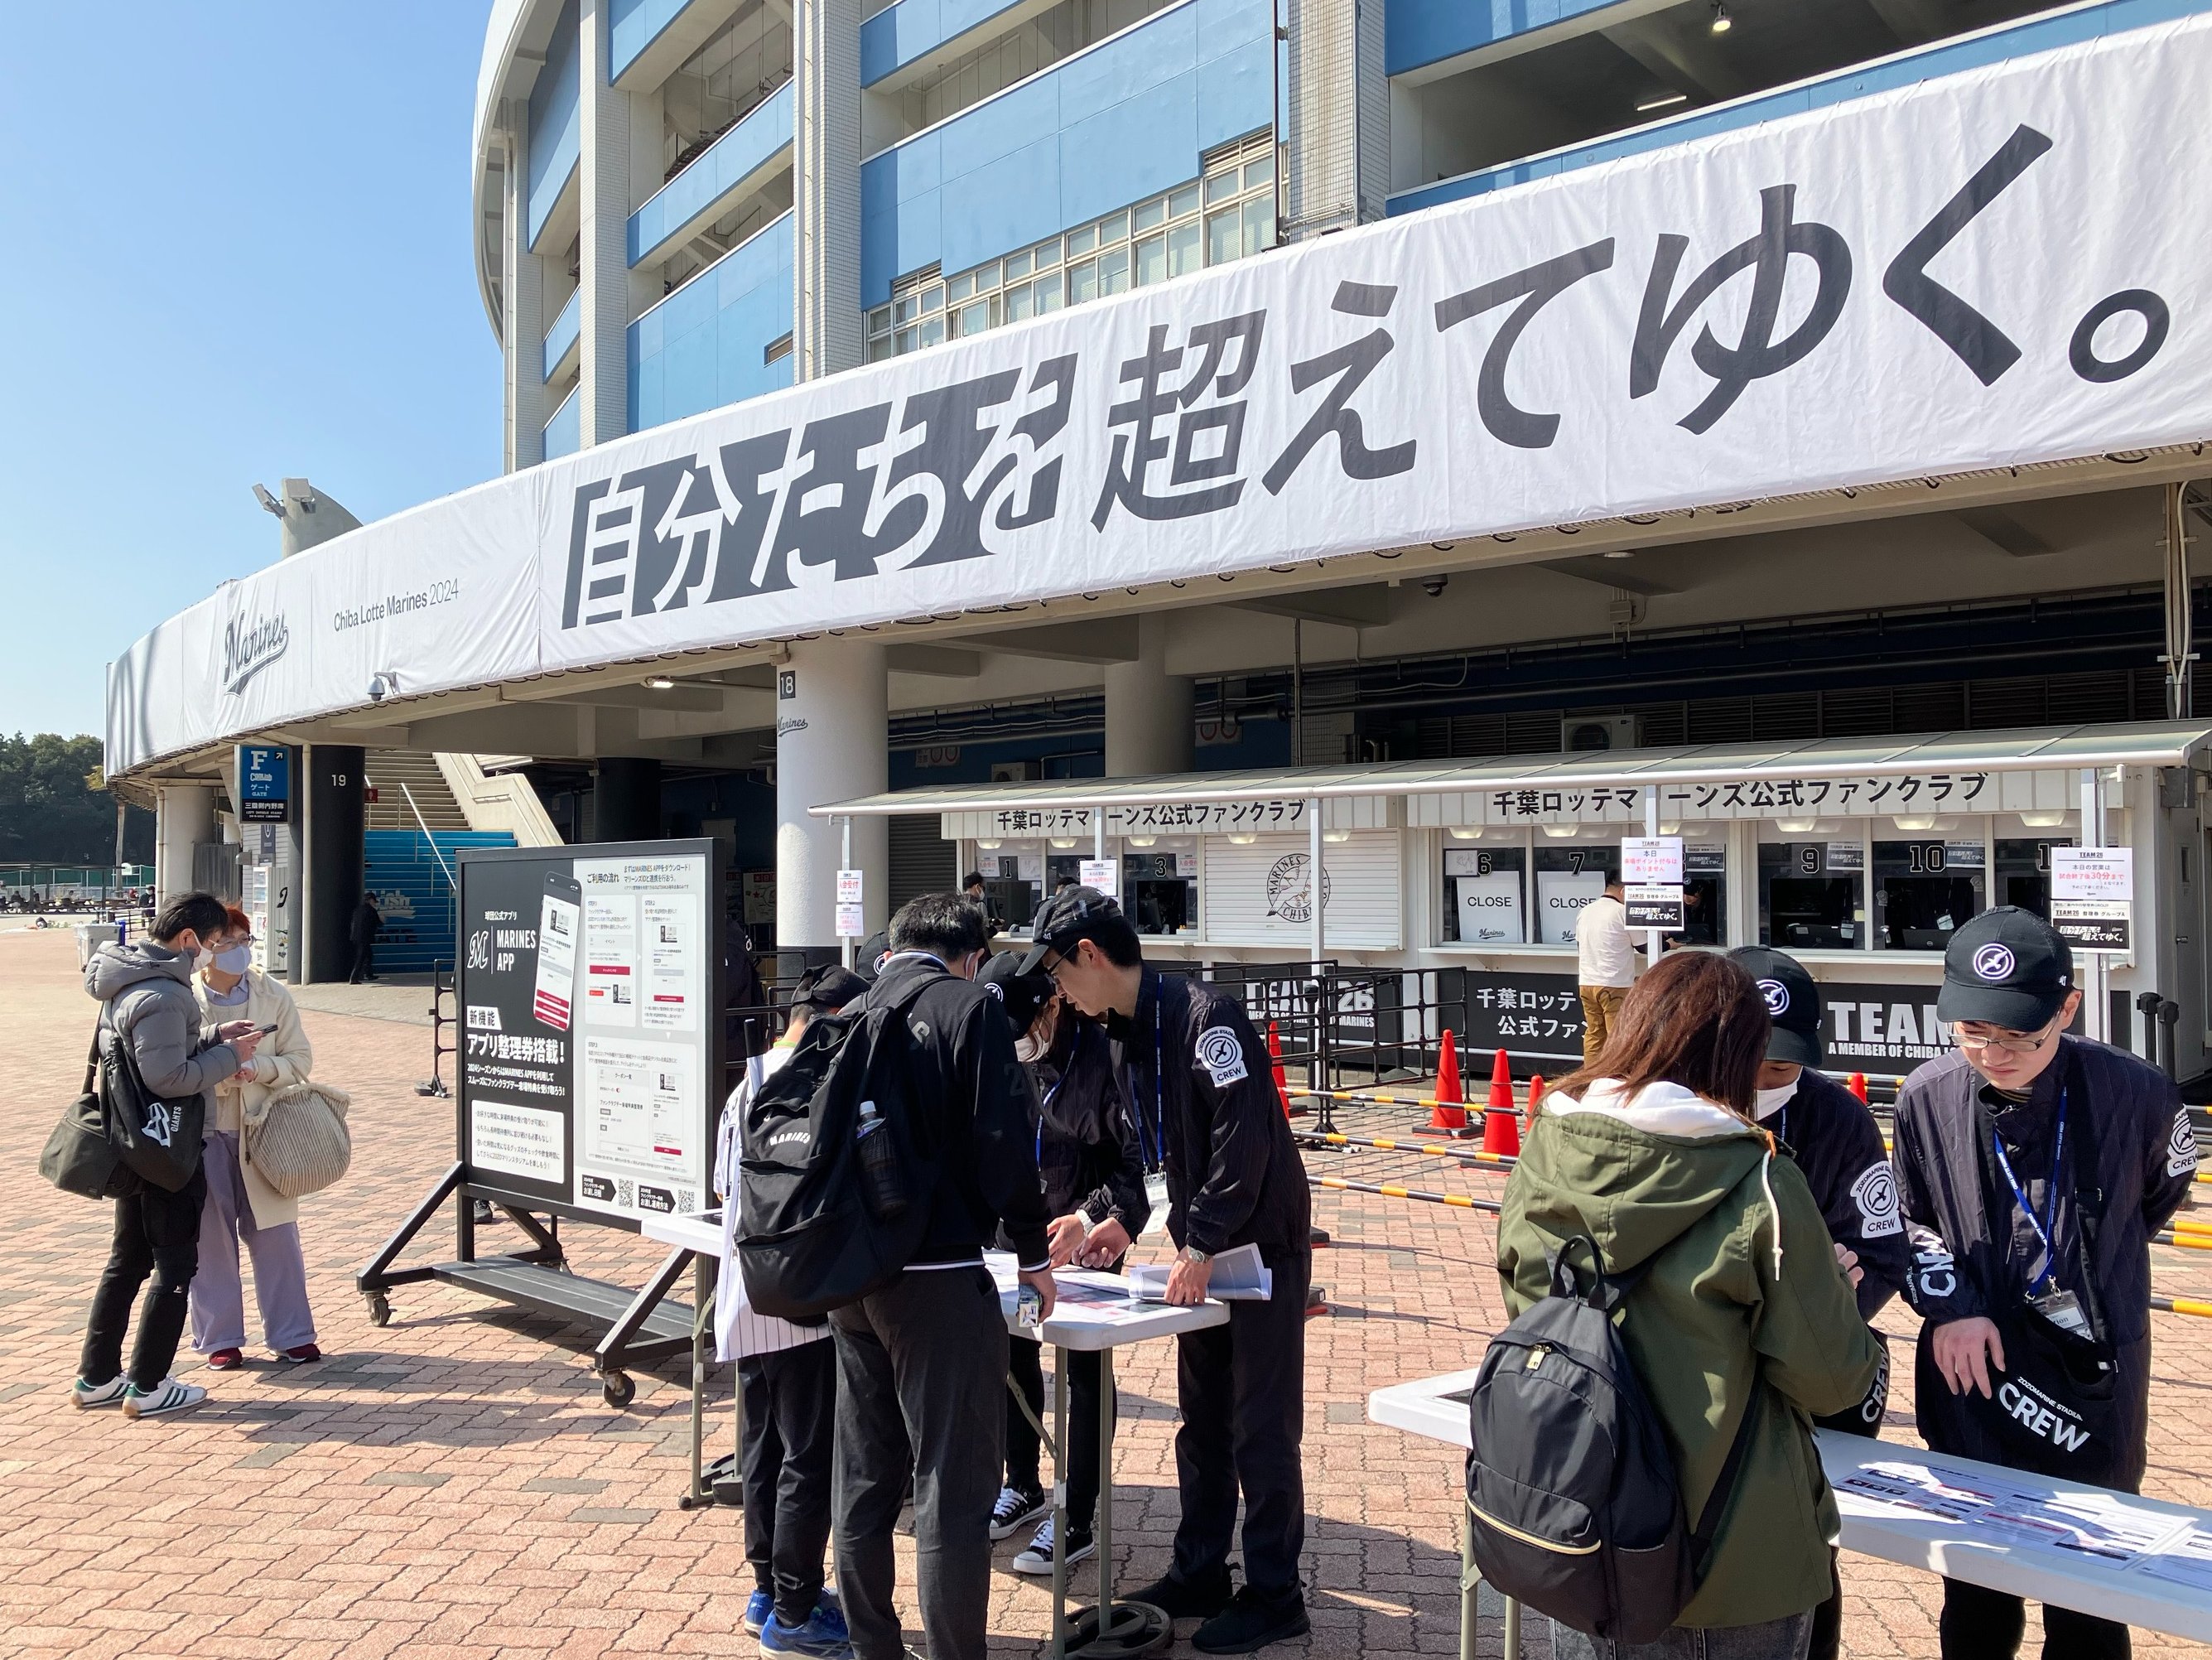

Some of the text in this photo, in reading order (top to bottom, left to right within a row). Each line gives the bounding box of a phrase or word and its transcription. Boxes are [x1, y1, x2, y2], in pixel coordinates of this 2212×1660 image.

[334, 577, 459, 632] Chiba Lotte Marines 2024
[224, 607, 289, 698] Marines
[780, 675, 793, 695] 18
[251, 750, 267, 770] F
[331, 774, 346, 786] 19
[1493, 772, 1988, 815] 千葉ロッテマーンズ公式ファンクラブ
[997, 799, 1305, 831] 千葉ロッテマーンズ公式ファンクラブ
[1154, 857, 1167, 878] 3
[1477, 852, 1492, 876] 6
[1569, 852, 1585, 876] 7
[1800, 847, 1819, 874] 9
[1910, 845, 1946, 872] 10
[587, 872, 619, 884] ご利用の流れ
[1005, 859, 1011, 879] 1
[1269, 856, 1301, 895] MARINES
[1467, 896, 1512, 907] CLOSE
[484, 910, 518, 921] 球団公式アプリ
[496, 929, 536, 949] MARINES
[2080, 933, 2123, 943] 超えてゆく。
[496, 953, 514, 972] APP
[470, 1009, 495, 1026] 新機能
[1828, 1042, 1837, 1055] A
[1838, 1042, 1887, 1058] MEMBER
[1888, 1044, 1903, 1058] OF
[1905, 1045, 1941, 1059] CHIBA
[1217, 1067, 1241, 1081] CREW
[170, 1106, 182, 1132] GIANTS
[769, 1132, 811, 1146] MARINES
[1867, 1218, 1896, 1232] CREW
[2017, 1376, 2056, 1407] ZOZOMARINE
[1999, 1382, 2091, 1453] CREW
